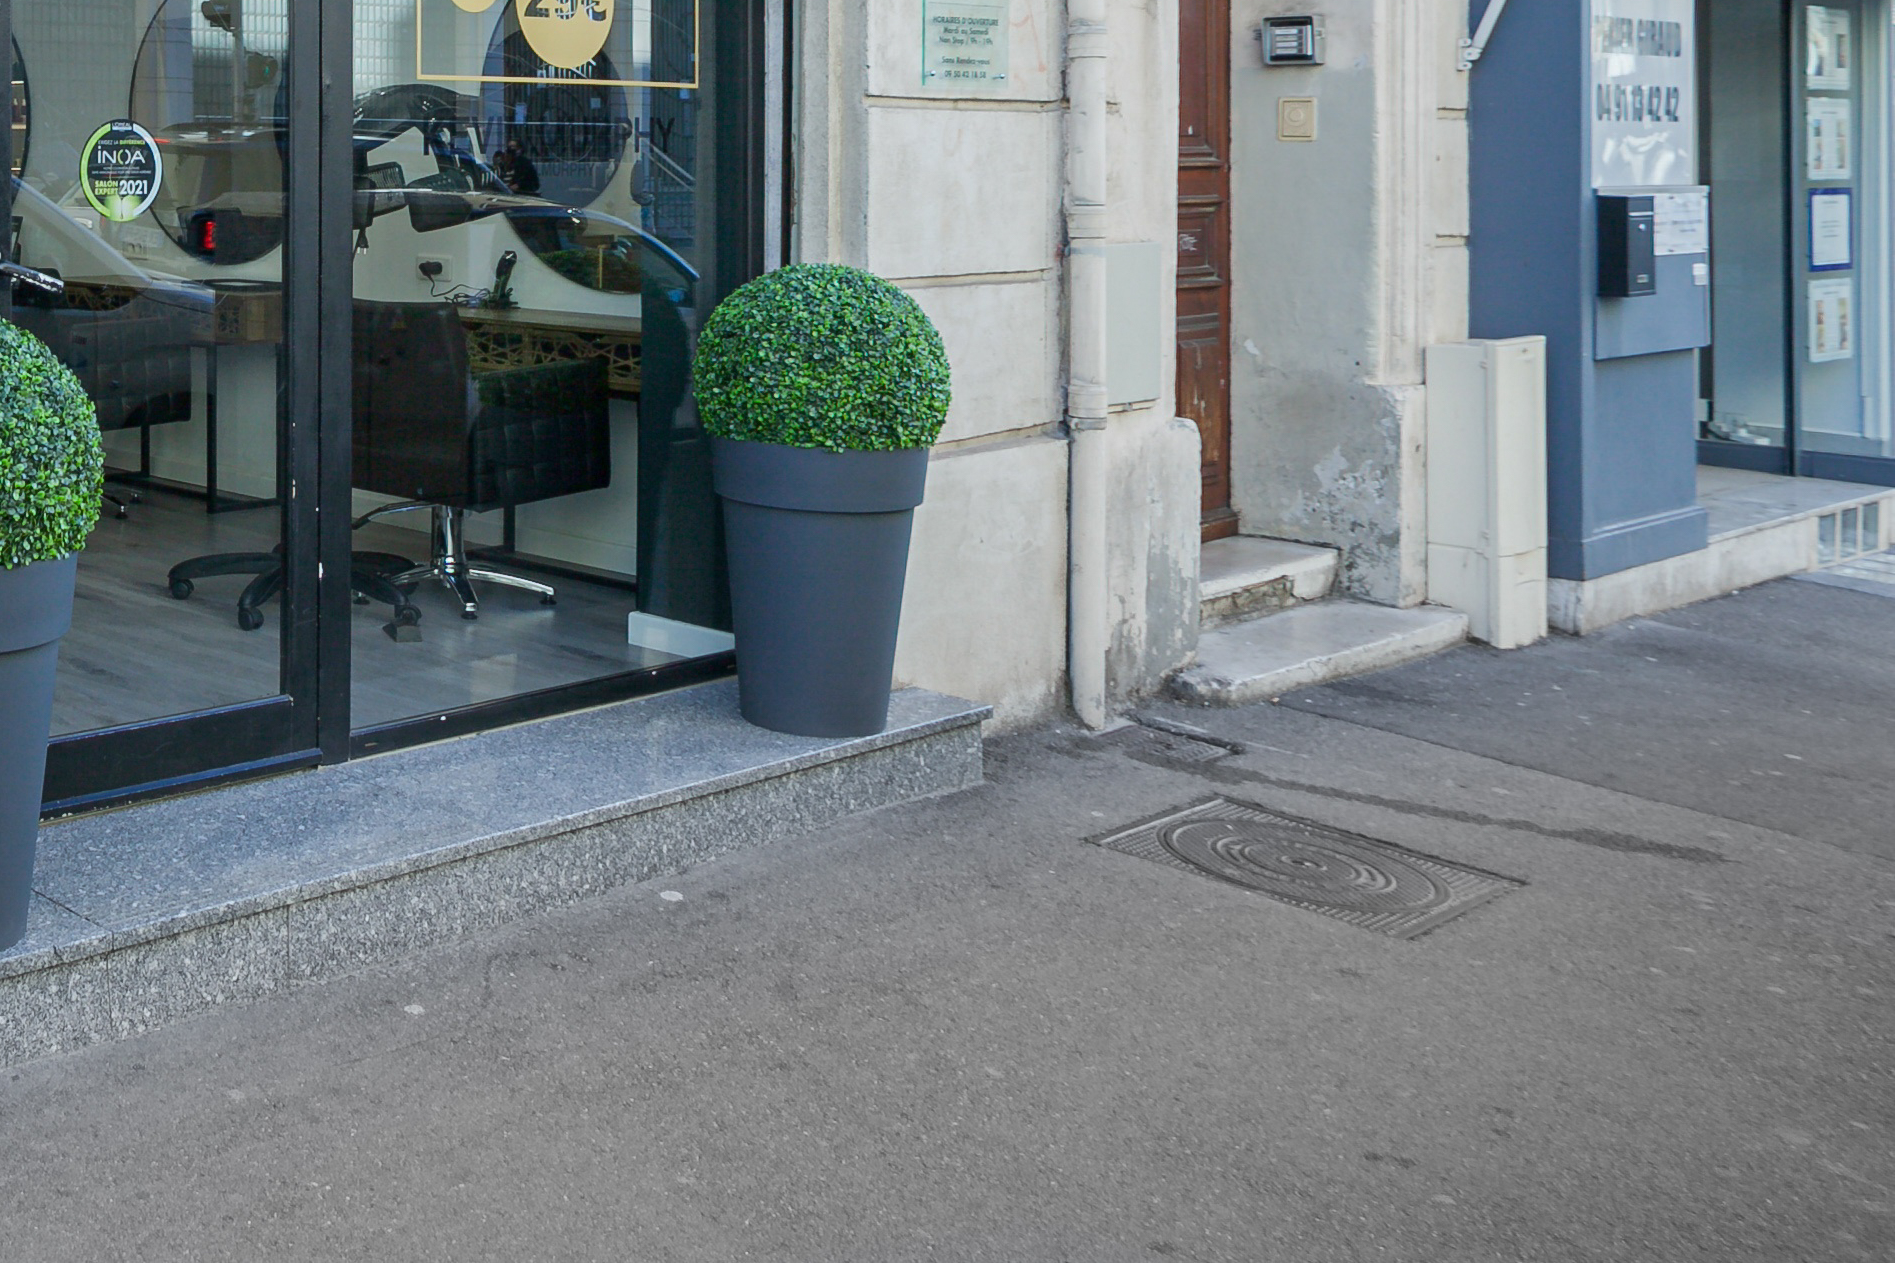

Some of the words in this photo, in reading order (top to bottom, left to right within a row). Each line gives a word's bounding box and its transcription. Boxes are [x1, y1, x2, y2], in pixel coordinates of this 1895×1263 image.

[94, 180, 119, 188] SALON
[119, 179, 148, 196] 2021
[94, 187, 119, 196] EXPERT
